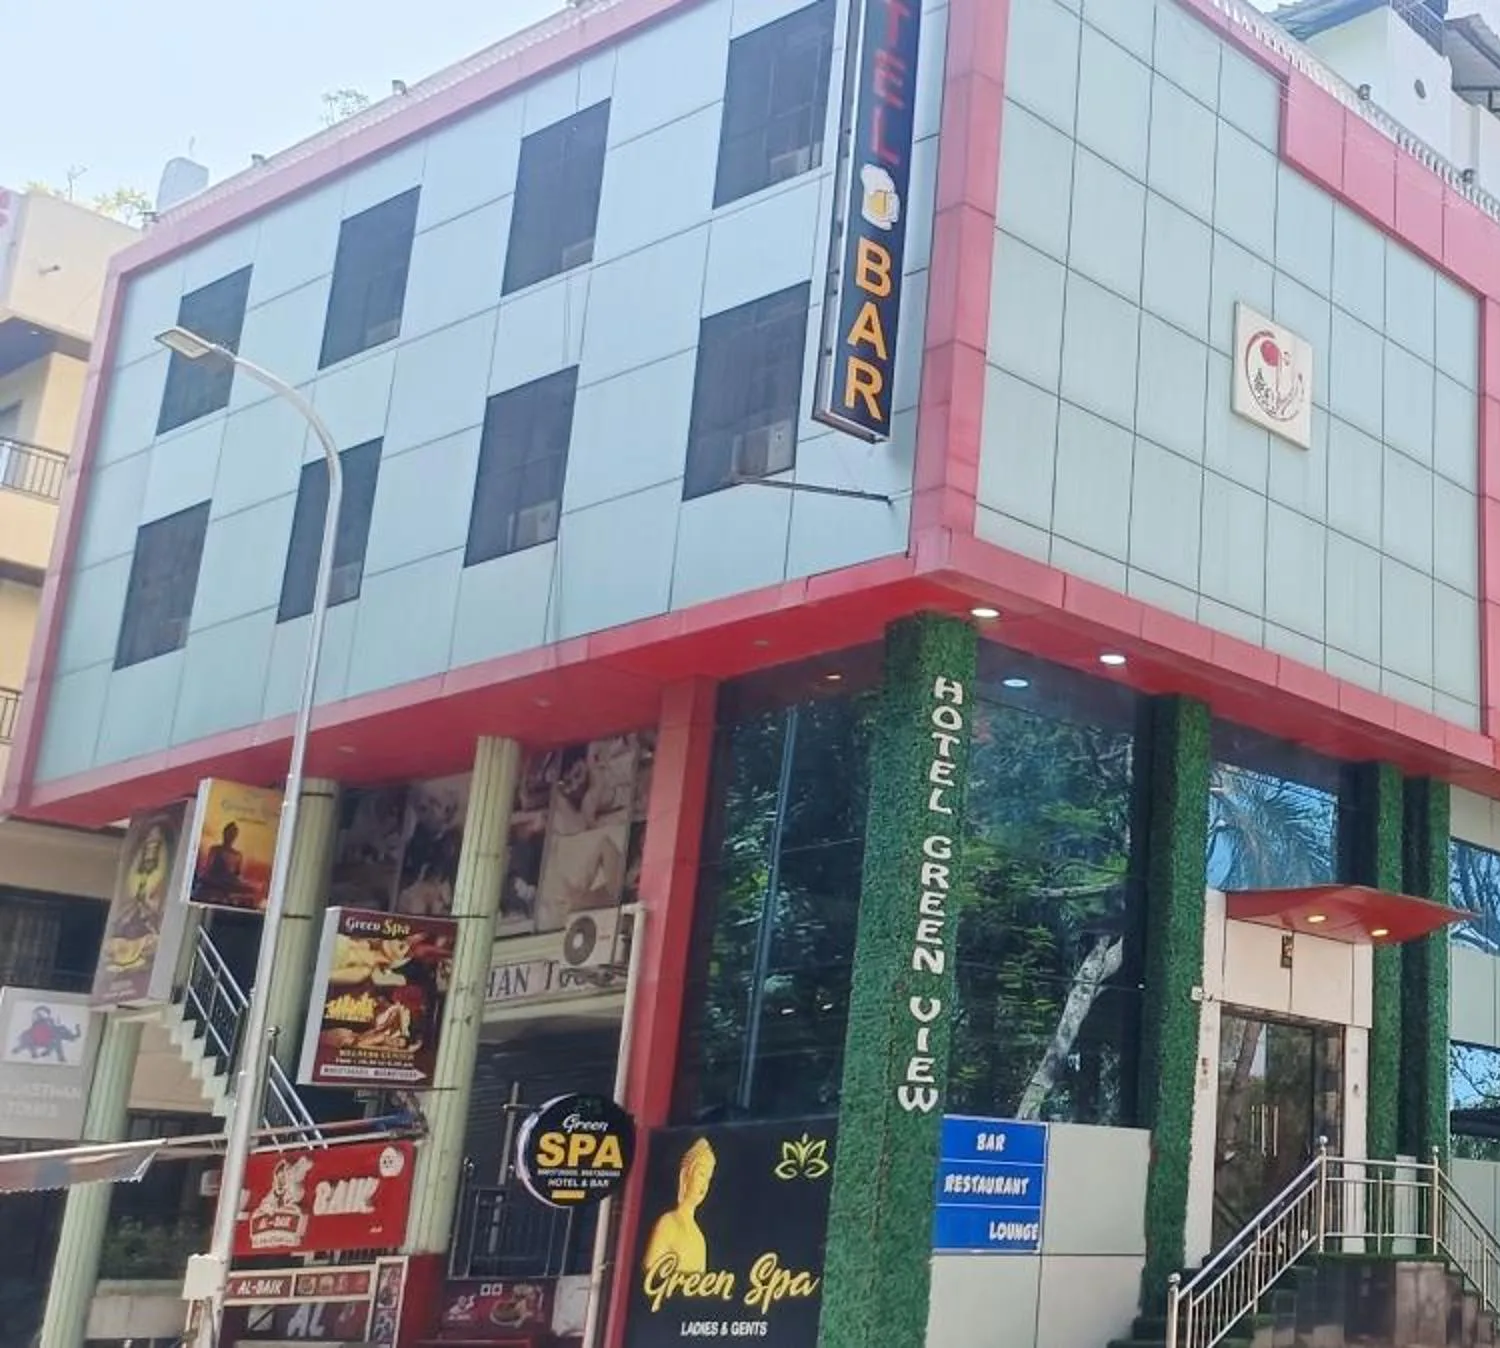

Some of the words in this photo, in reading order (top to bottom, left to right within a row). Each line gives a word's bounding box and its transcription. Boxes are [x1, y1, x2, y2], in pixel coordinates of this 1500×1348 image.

[845, 236, 892, 422] BAR
[927, 676, 963, 815] HOTEL
[912, 834, 952, 974] GREEN
[345, 917, 380, 931] Green
[381, 918, 411, 936] Spa
[897, 996, 941, 1112] VIEW
[562, 1113, 609, 1133] Green
[536, 1132, 623, 1169] SPA
[976, 1133, 1006, 1152] BAR
[547, 1178, 579, 1188] HOTEL
[943, 1173, 1030, 1195] RESTAURANT
[313, 1176, 380, 1216] BAIK
[989, 1221, 1039, 1241] LOUNGE
[237, 1279, 285, 1295] AL-BAIK
[644, 1252, 736, 1313] Green
[744, 1252, 821, 1315] Spa
[681, 1321, 719, 1336] LADIES
[720, 1321, 728, 1336] &
[730, 1321, 768, 1337] GENTS
